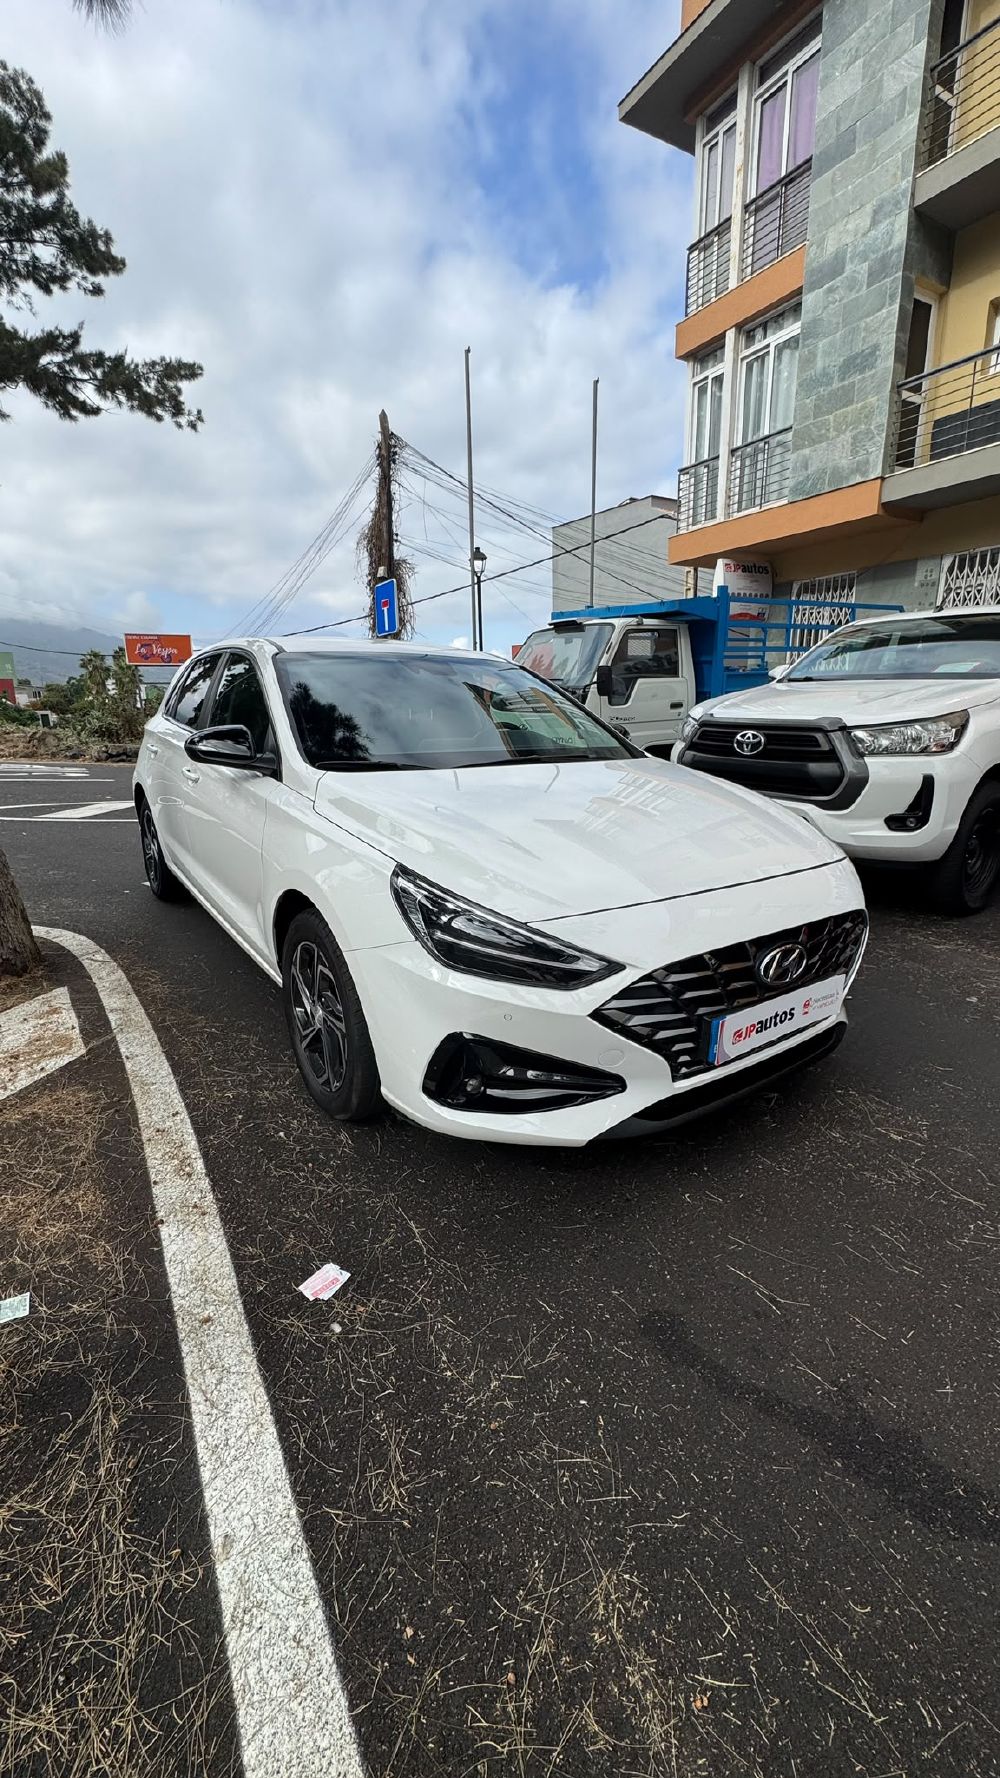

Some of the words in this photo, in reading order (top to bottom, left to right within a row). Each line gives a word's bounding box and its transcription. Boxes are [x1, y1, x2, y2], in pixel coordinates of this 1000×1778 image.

[733, 563, 770, 575] JPautos
[135, 643, 147, 654] La
[152, 643, 178, 658] Vespa
[743, 1007, 795, 1041] JPautos
